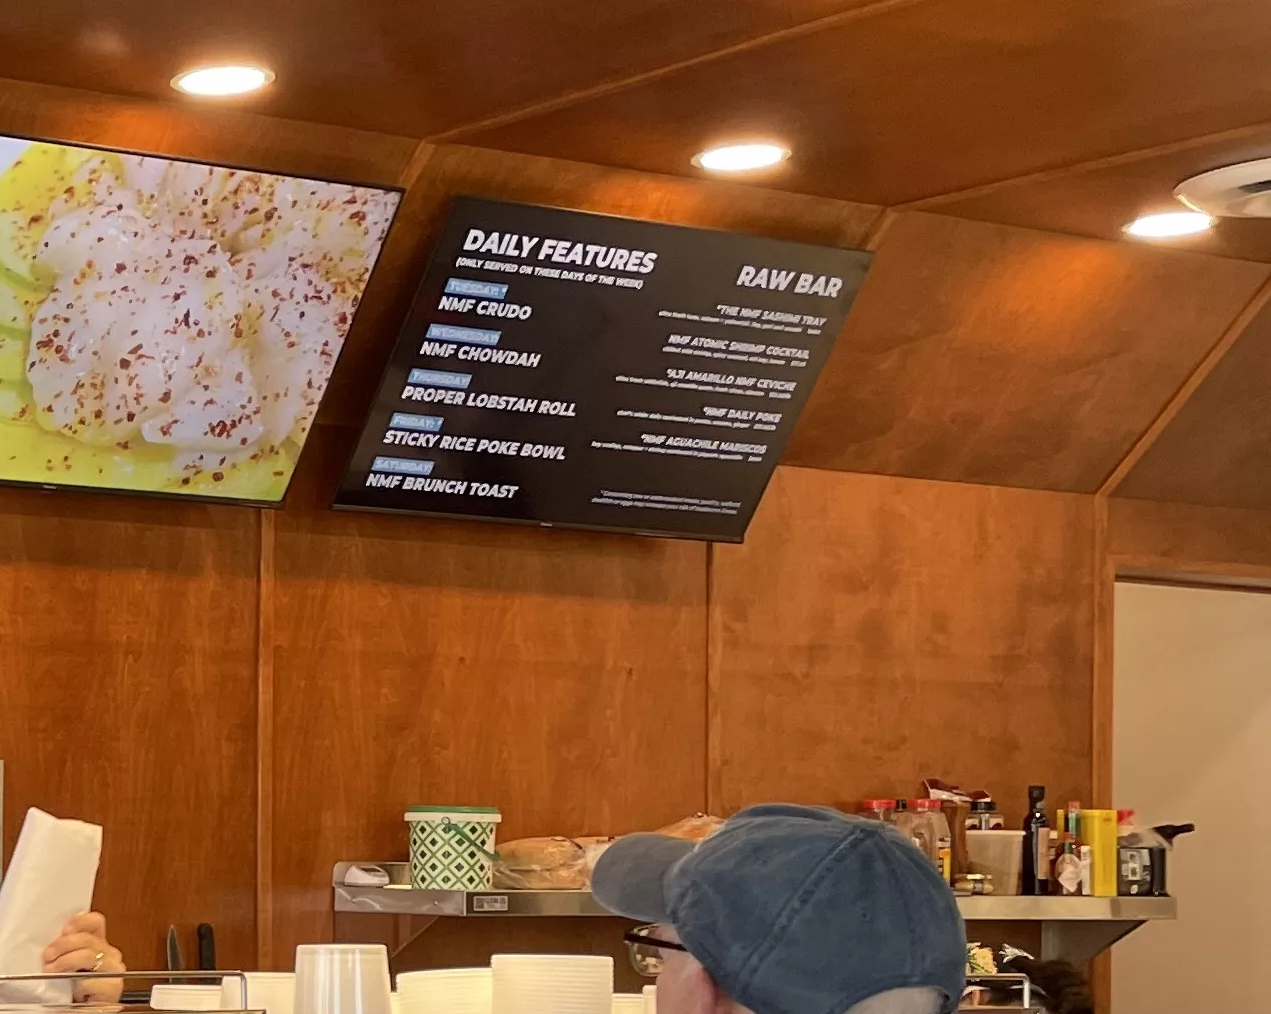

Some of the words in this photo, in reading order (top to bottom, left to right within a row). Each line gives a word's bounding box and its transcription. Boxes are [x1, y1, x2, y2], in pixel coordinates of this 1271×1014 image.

[462, 228, 539, 257] DAILY
[537, 238, 657, 273] FEATURES
[736, 265, 796, 290] RAW
[793, 273, 842, 297] BAR
[437, 295, 476, 312] NMF
[475, 300, 531, 319] CRUDO
[419, 341, 457, 357] NMF
[457, 345, 541, 367] CHOWDAH
[401, 385, 465, 404] PROPER
[466, 392, 538, 412] LOBSTAH
[537, 400, 575, 416] ROLL
[382, 429, 440, 447] STICKY
[439, 435, 476, 451] RICE
[476, 439, 520, 455] POKE
[519, 443, 565, 459] BOWL
[365, 473, 402, 488] NMF
[401, 476, 467, 494] BRUNCH
[469, 482, 519, 498] TOAST
